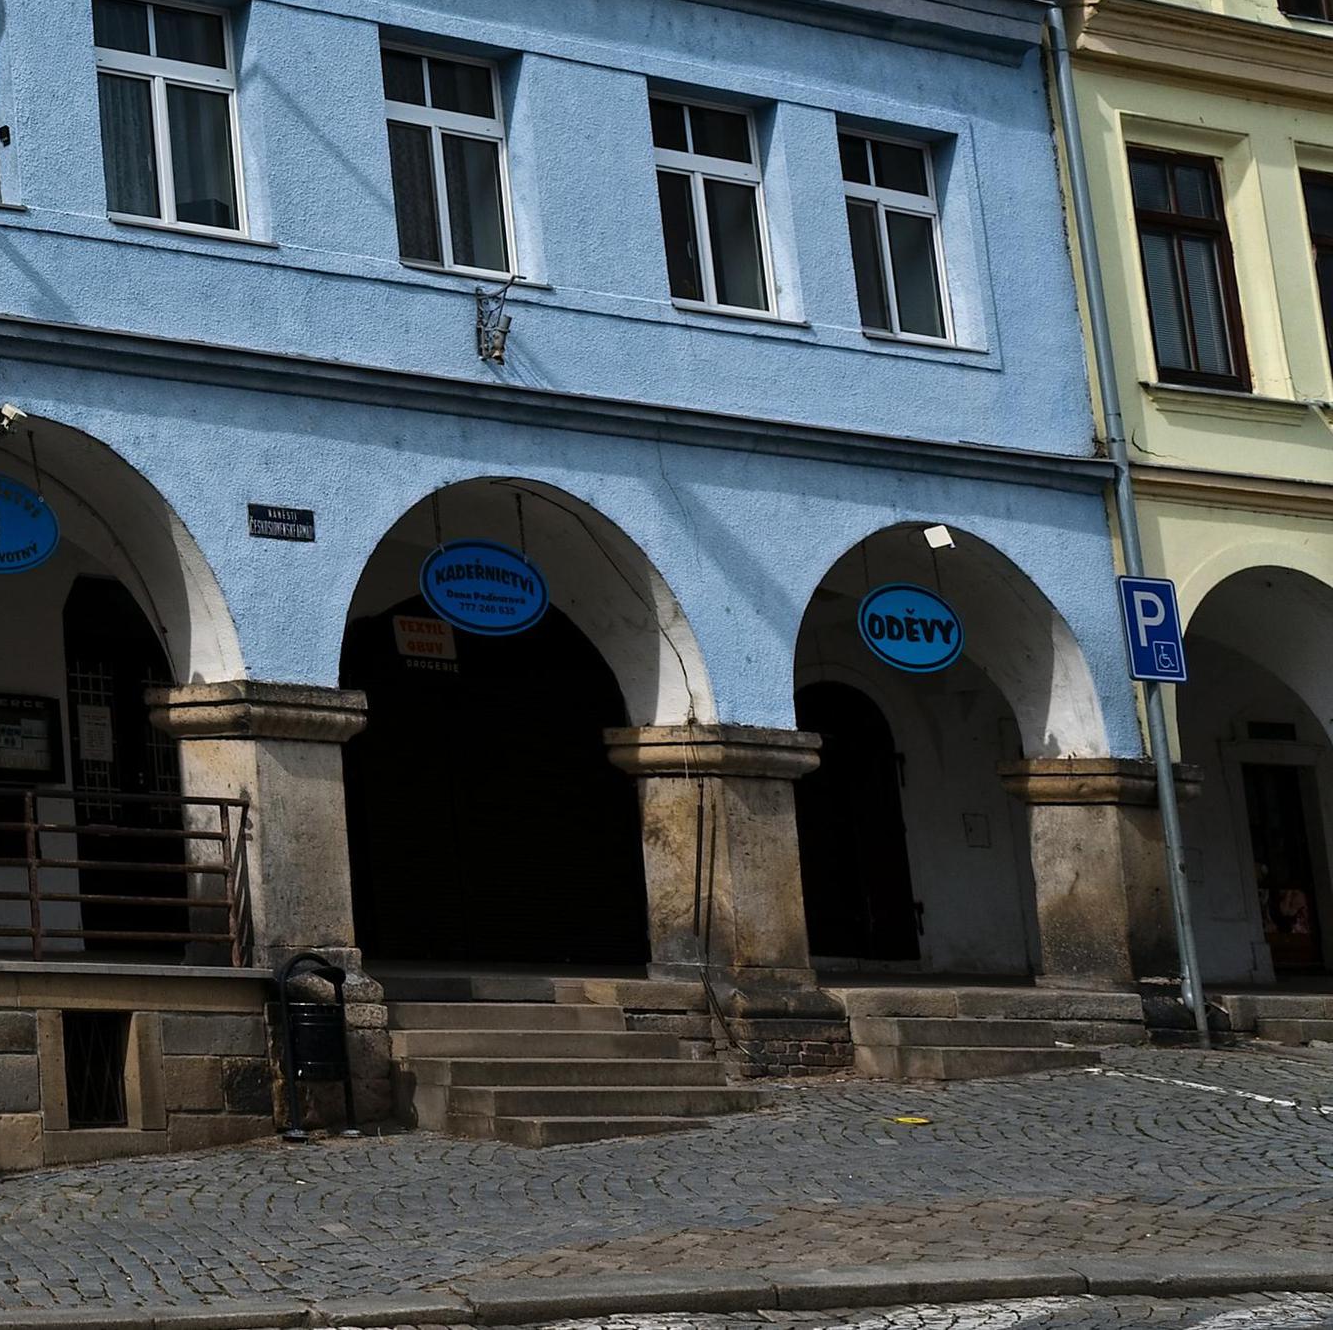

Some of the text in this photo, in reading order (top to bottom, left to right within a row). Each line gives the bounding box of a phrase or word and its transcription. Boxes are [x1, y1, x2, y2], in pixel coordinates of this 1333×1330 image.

[399, 619, 446, 635] TEXTIL
[868, 608, 955, 645] ODĚVY
[1133, 590, 1166, 647] P
[405, 640, 443, 655] OBUV
